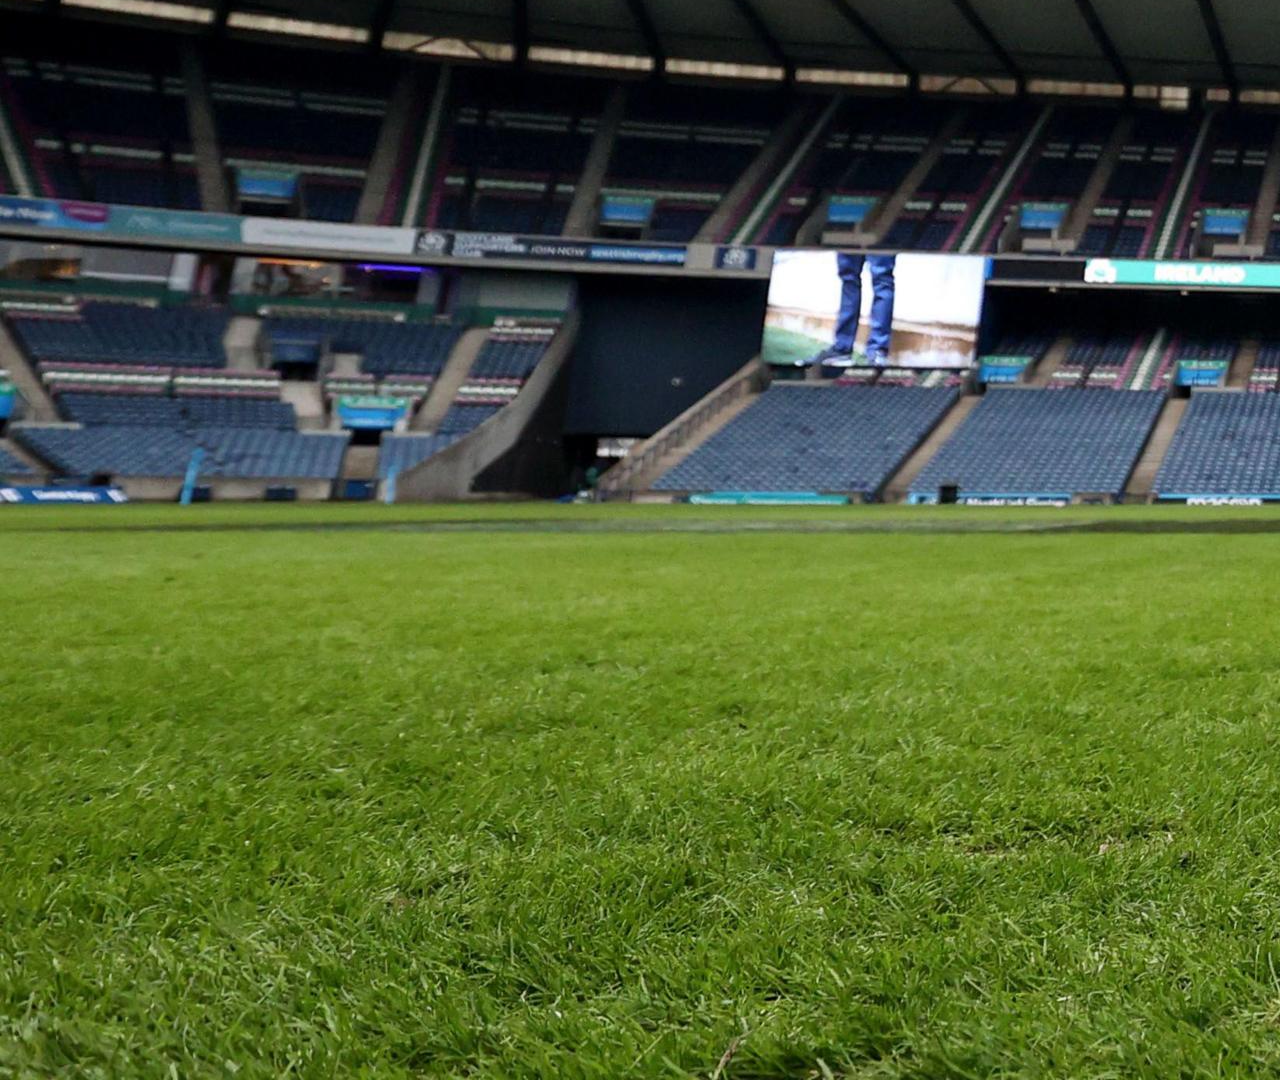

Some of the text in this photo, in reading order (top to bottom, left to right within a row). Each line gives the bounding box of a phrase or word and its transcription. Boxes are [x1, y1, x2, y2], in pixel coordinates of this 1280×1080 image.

[531, 245, 586, 257] JOIN NOW
[1154, 264, 1246, 284] IRELAND
